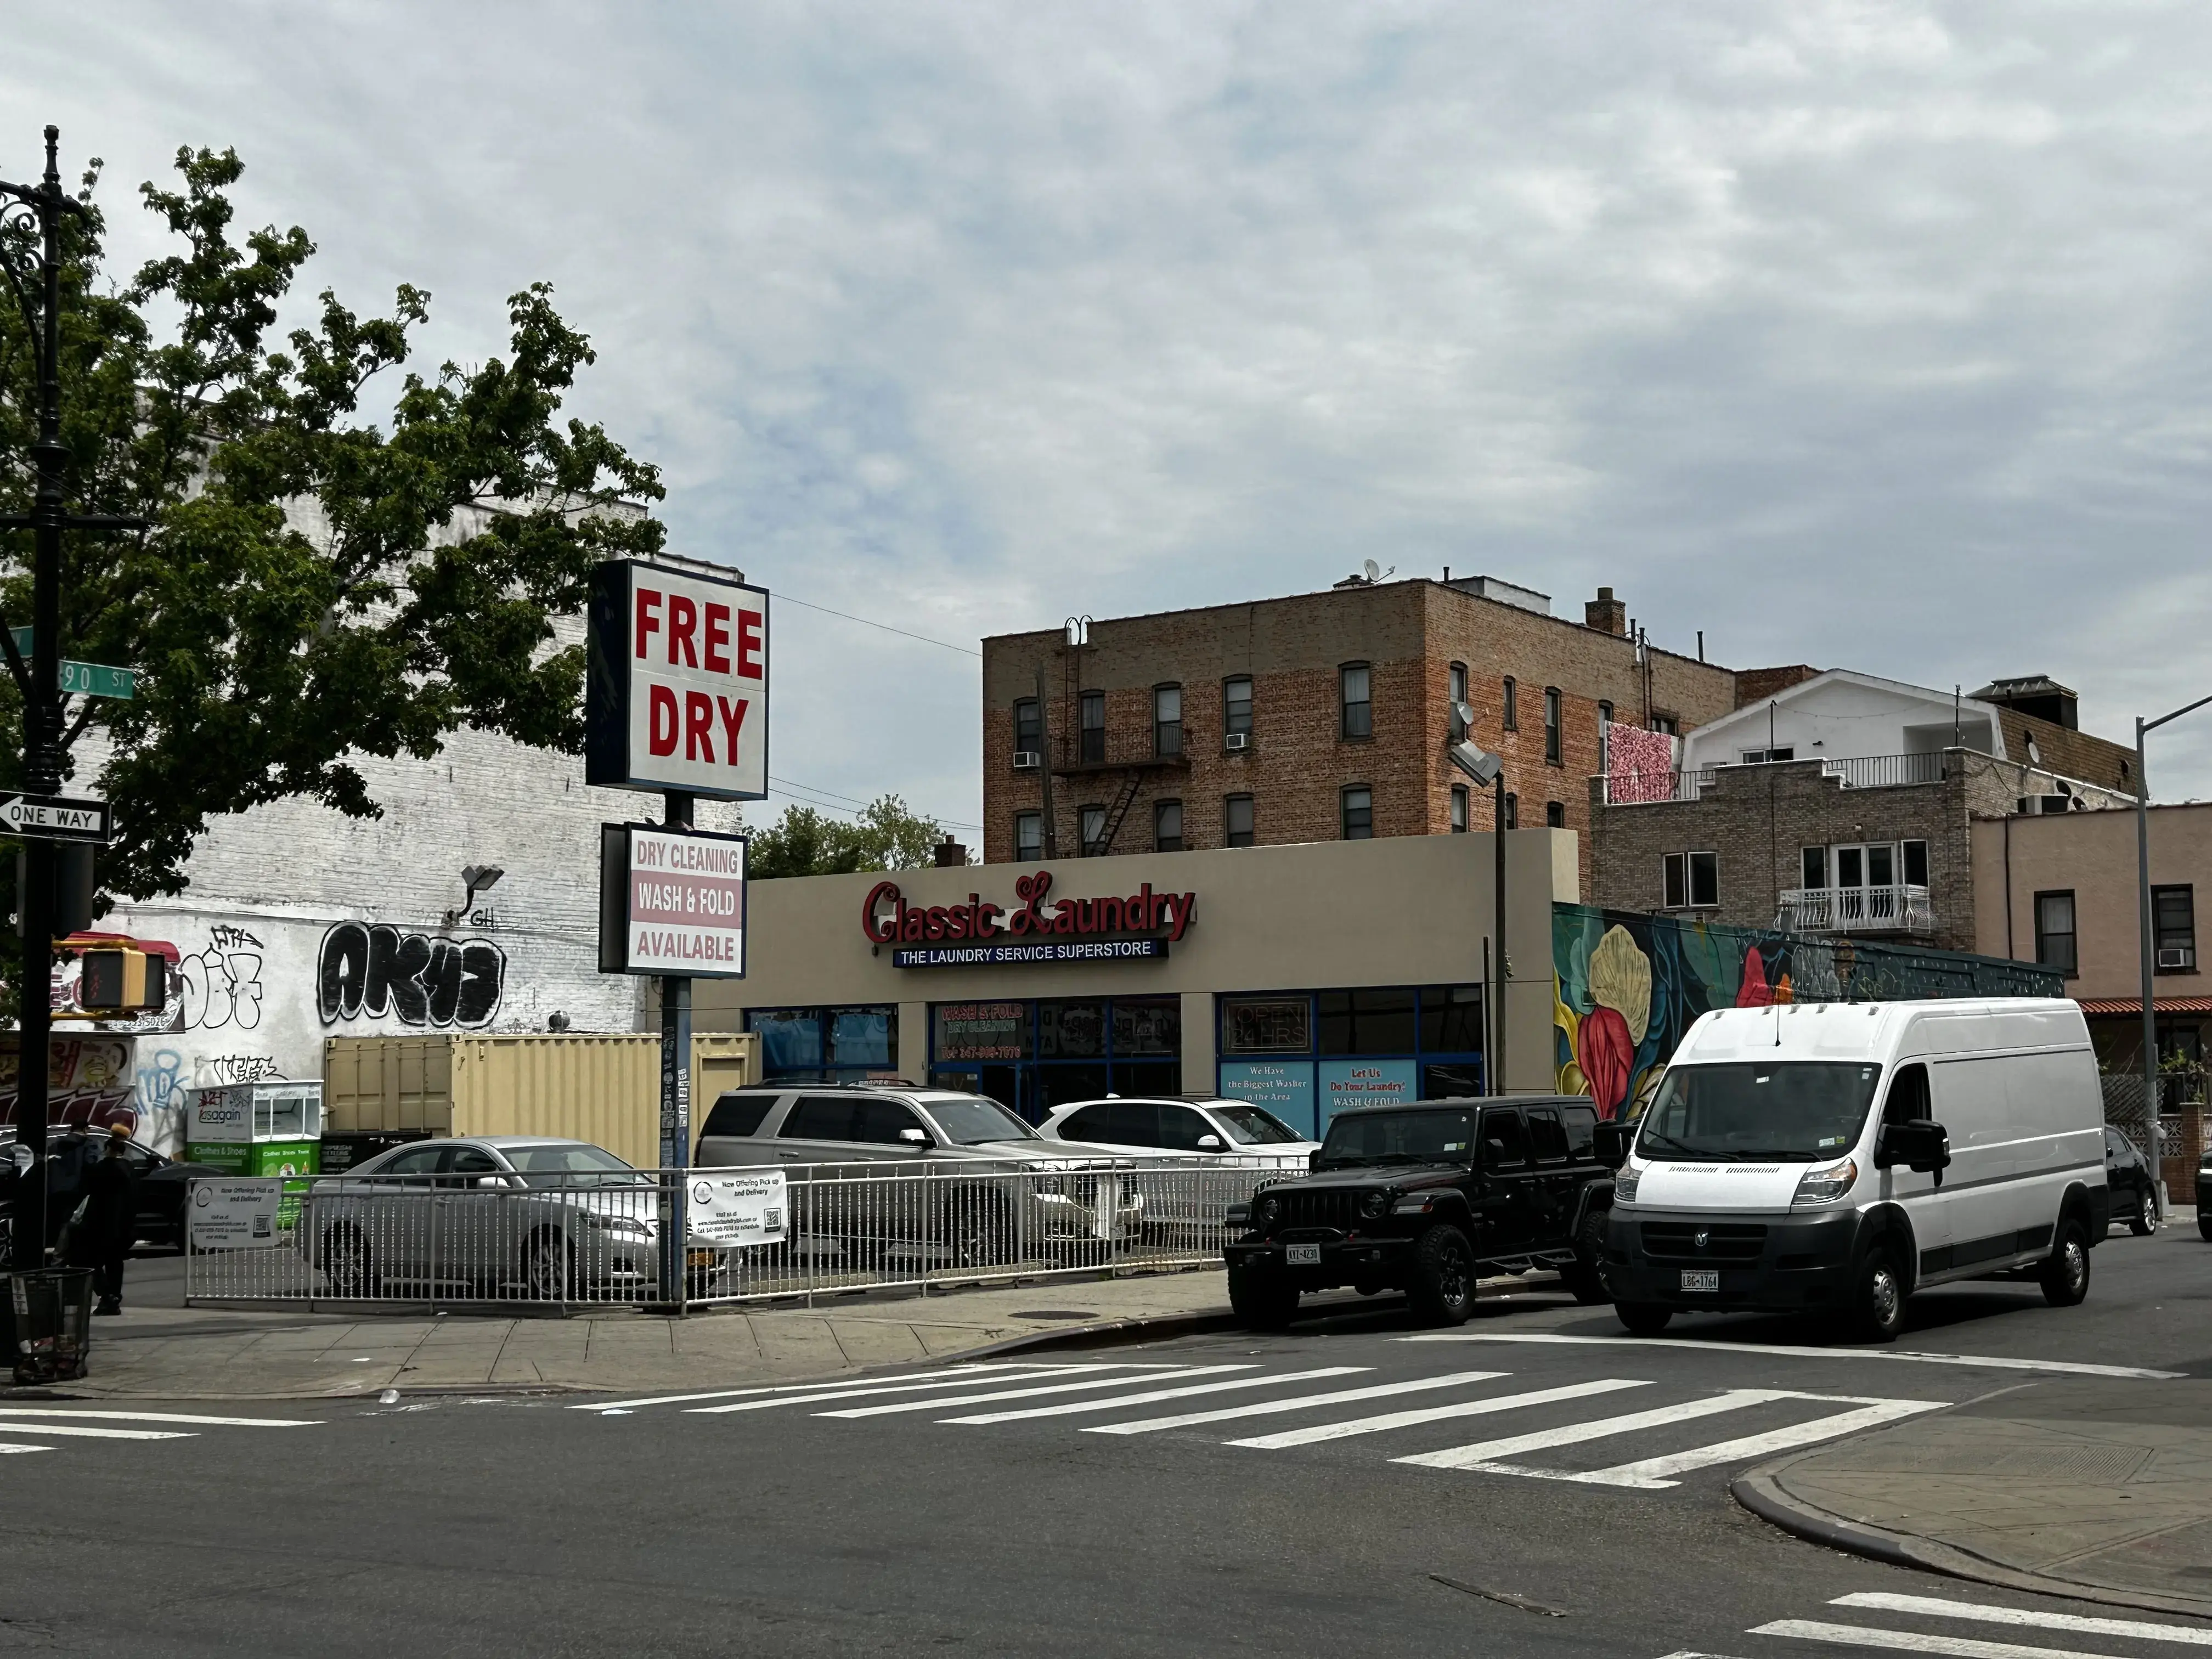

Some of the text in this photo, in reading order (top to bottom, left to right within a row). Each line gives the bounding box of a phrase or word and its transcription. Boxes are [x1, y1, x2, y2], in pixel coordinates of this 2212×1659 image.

[636, 588, 763, 680] FREE
[65, 665, 126, 689] 90 ST
[650, 684, 749, 766] DRY
[10, 806, 93, 827] ONE WAY
[637, 840, 738, 874] DRY CLEANING
[639, 882, 735, 916] WASH & FOLD
[862, 871, 1197, 944] Classic Laundry
[636, 931, 734, 961] AVAILABLE
[901, 941, 1151, 964] THE LAUNDRY SERVICE SUPERSTORE
[1237, 1006, 1301, 1024] OPEN
[1233, 1027, 1306, 1045] 24 HRS
[1250, 1066, 1284, 1075] We Have
[1351, 1068, 1381, 1078] Let Us
[1244, 1080, 1273, 1090] Biggest
[1276, 1080, 1307, 1088] Washer
[1330, 1081, 1342, 1091] Do
[1344, 1081, 1364, 1091] Your
[1333, 1097, 1361, 1107] WASH
